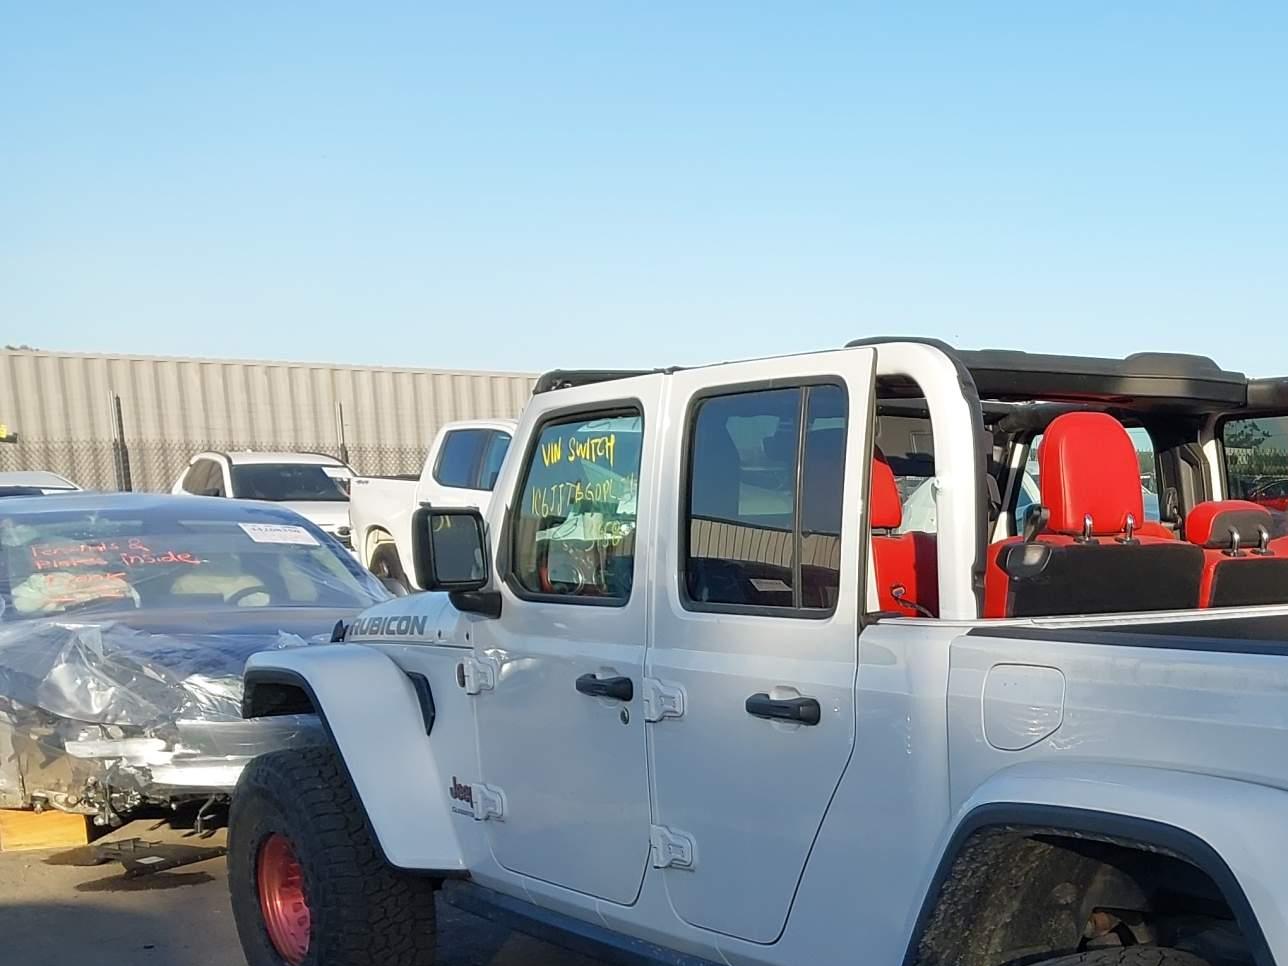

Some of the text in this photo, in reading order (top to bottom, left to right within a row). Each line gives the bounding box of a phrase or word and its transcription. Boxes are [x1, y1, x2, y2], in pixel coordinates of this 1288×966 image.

[542, 433, 616, 469] VIN SWITCH
[127, 537, 151, 552] &
[349, 615, 428, 636] RUBICON
[449, 775, 474, 809] Jeep
